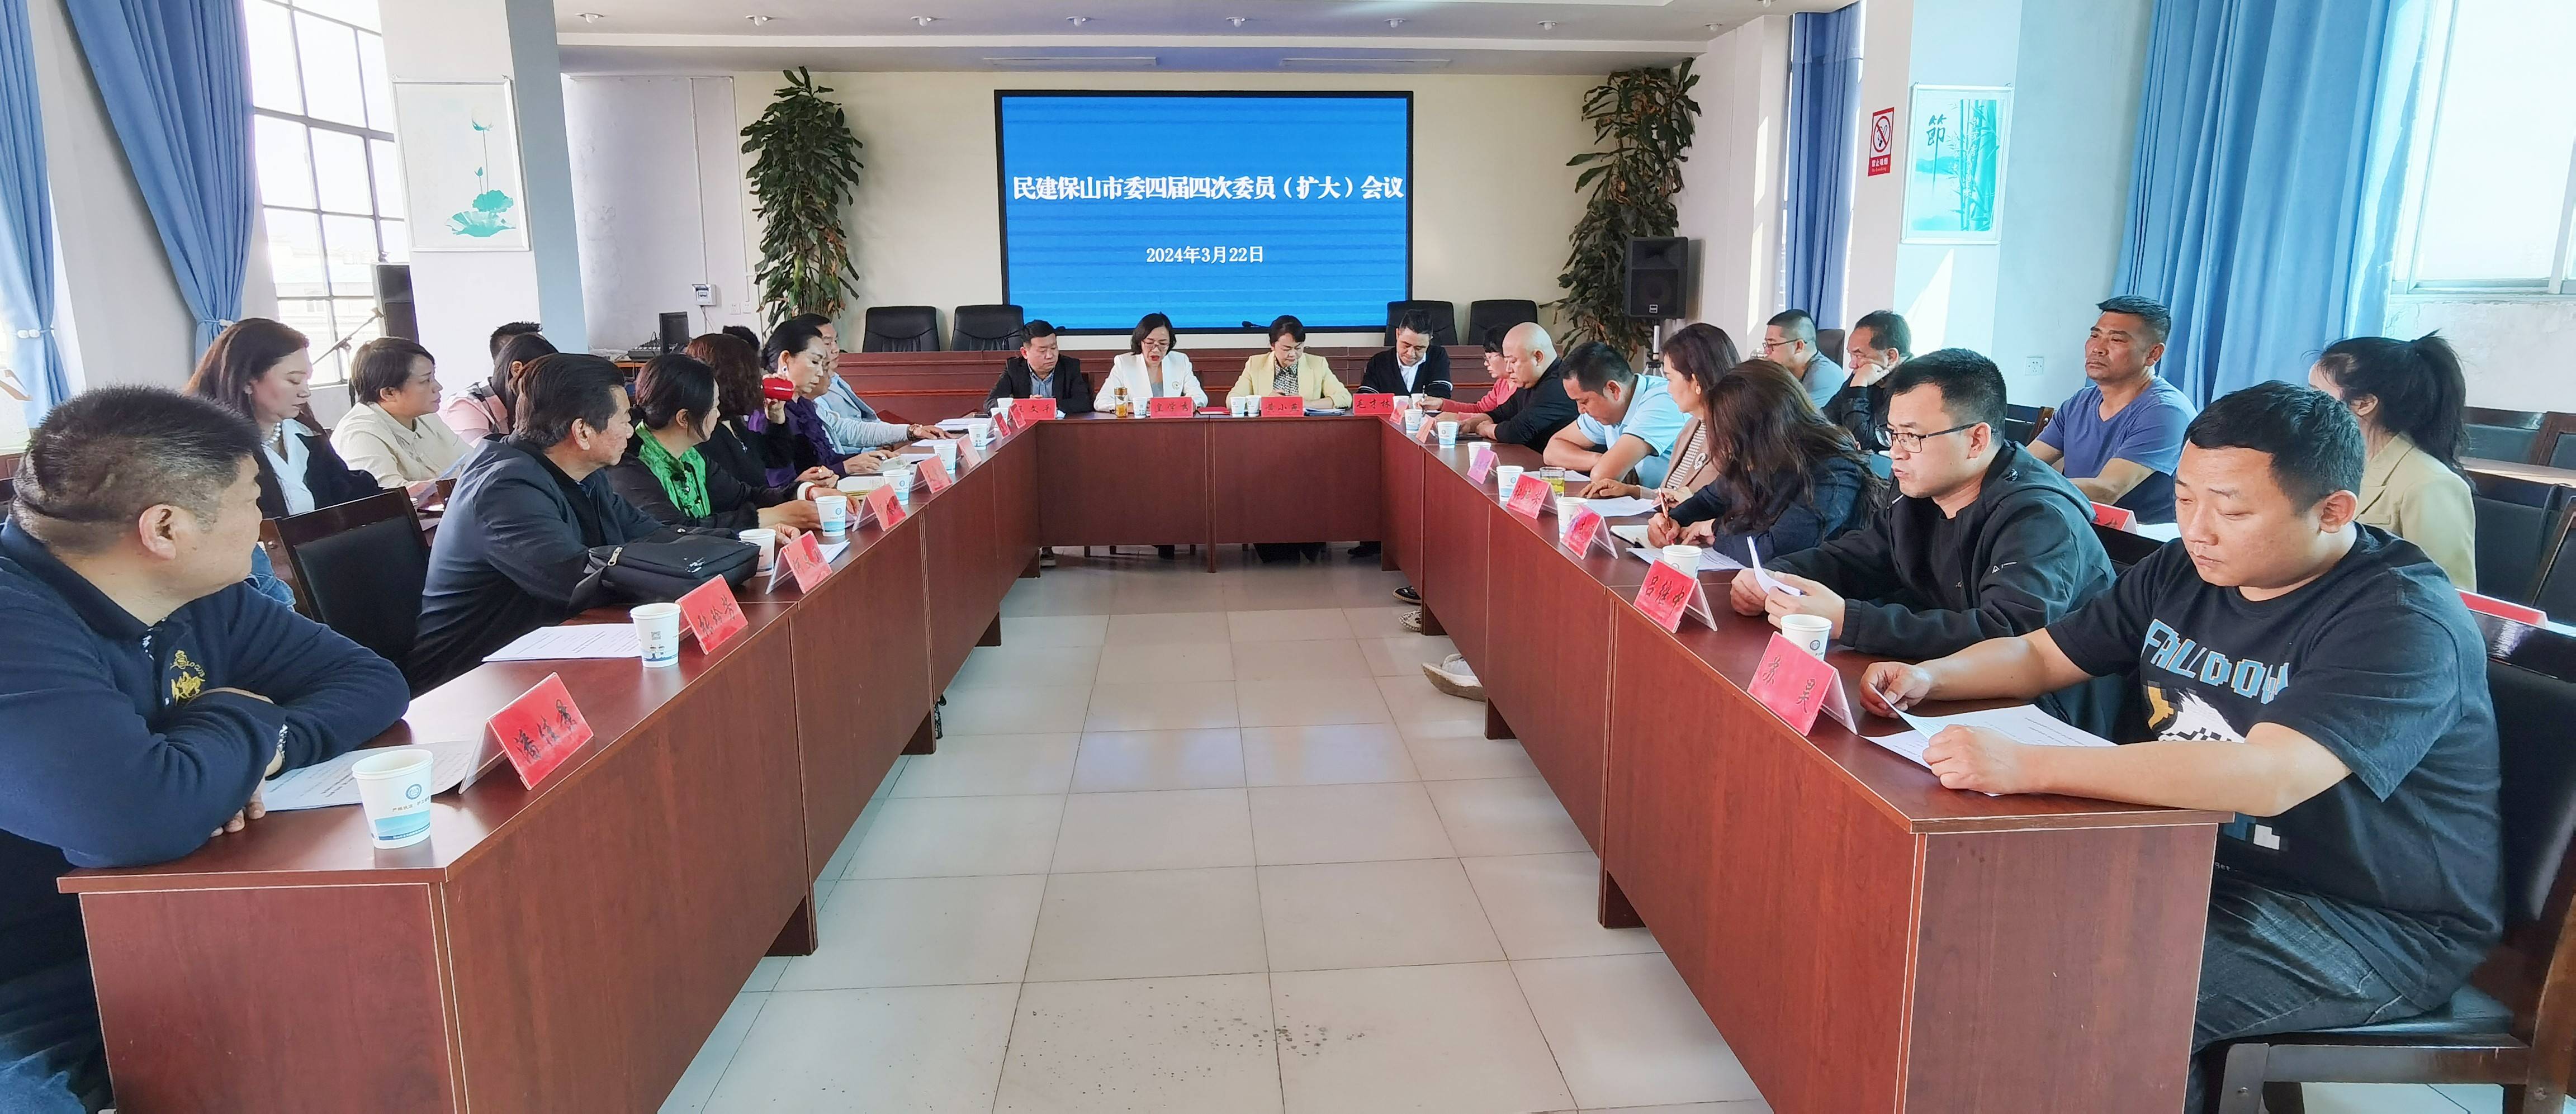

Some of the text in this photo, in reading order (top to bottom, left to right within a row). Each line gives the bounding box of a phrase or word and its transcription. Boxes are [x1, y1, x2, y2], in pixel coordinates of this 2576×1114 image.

[1013, 176, 1404, 200] 民建保山市委四届四次委员（扩大）会议
[1146, 246, 1263, 264] 2024年3月22日
